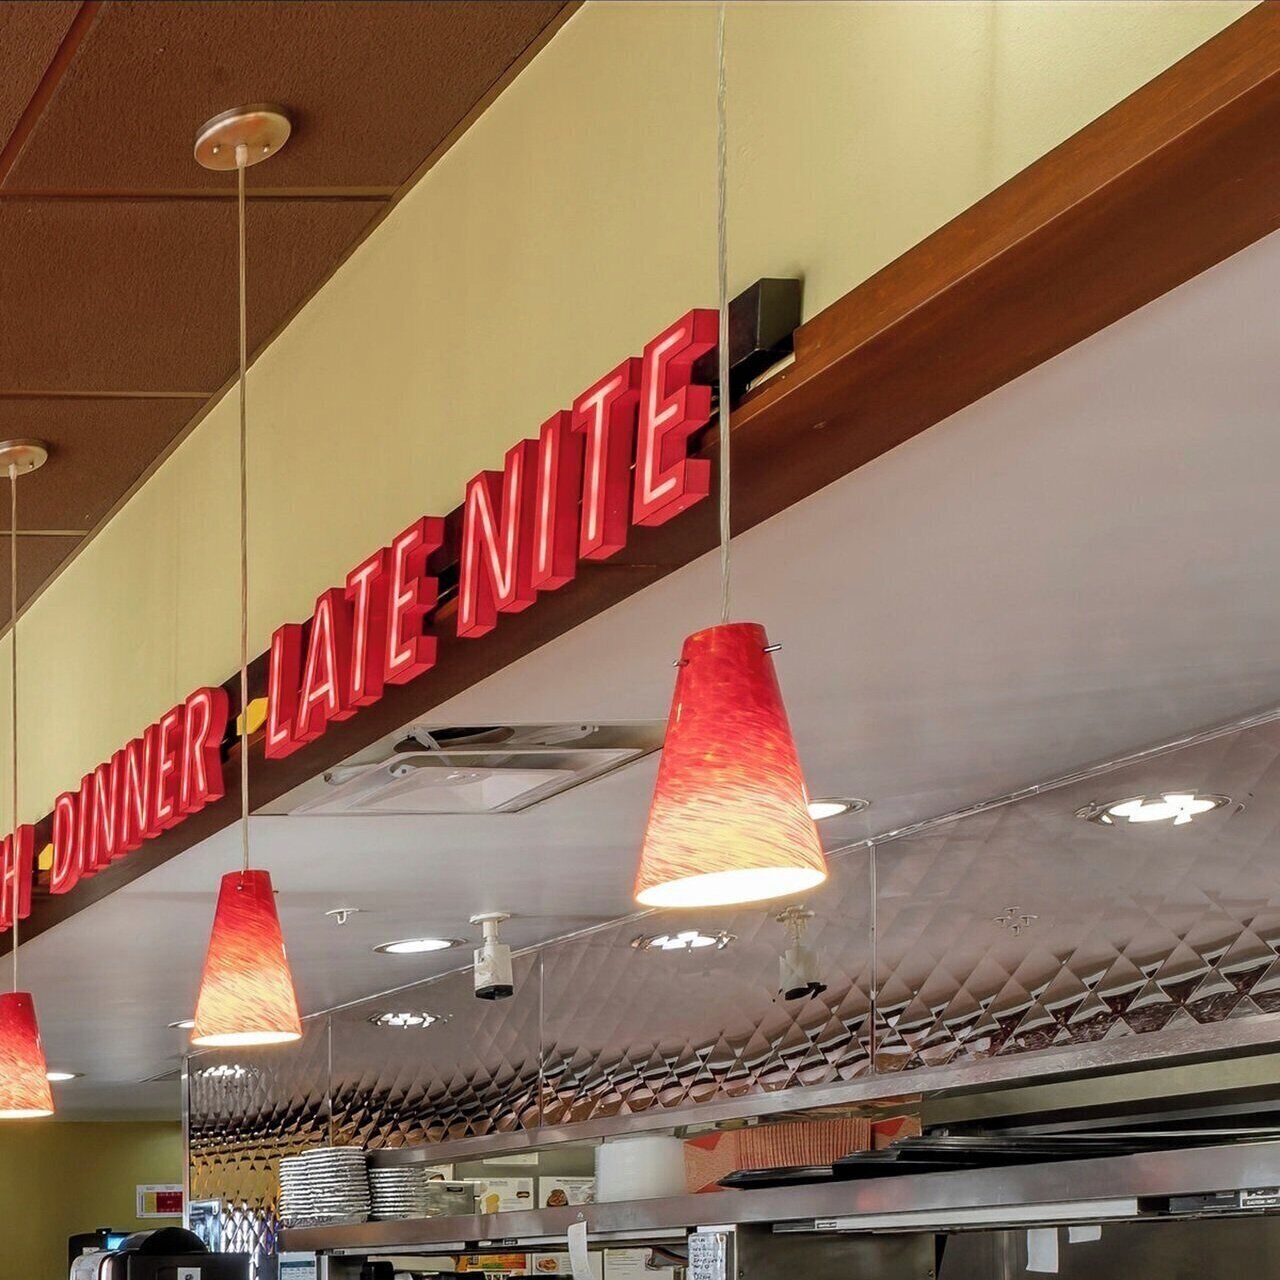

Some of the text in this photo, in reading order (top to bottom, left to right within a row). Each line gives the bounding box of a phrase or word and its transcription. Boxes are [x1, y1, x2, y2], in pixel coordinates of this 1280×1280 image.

[50, 687, 229, 894] DINNER
[265, 516, 445, 759] LATE
[457, 309, 720, 638] NITE
